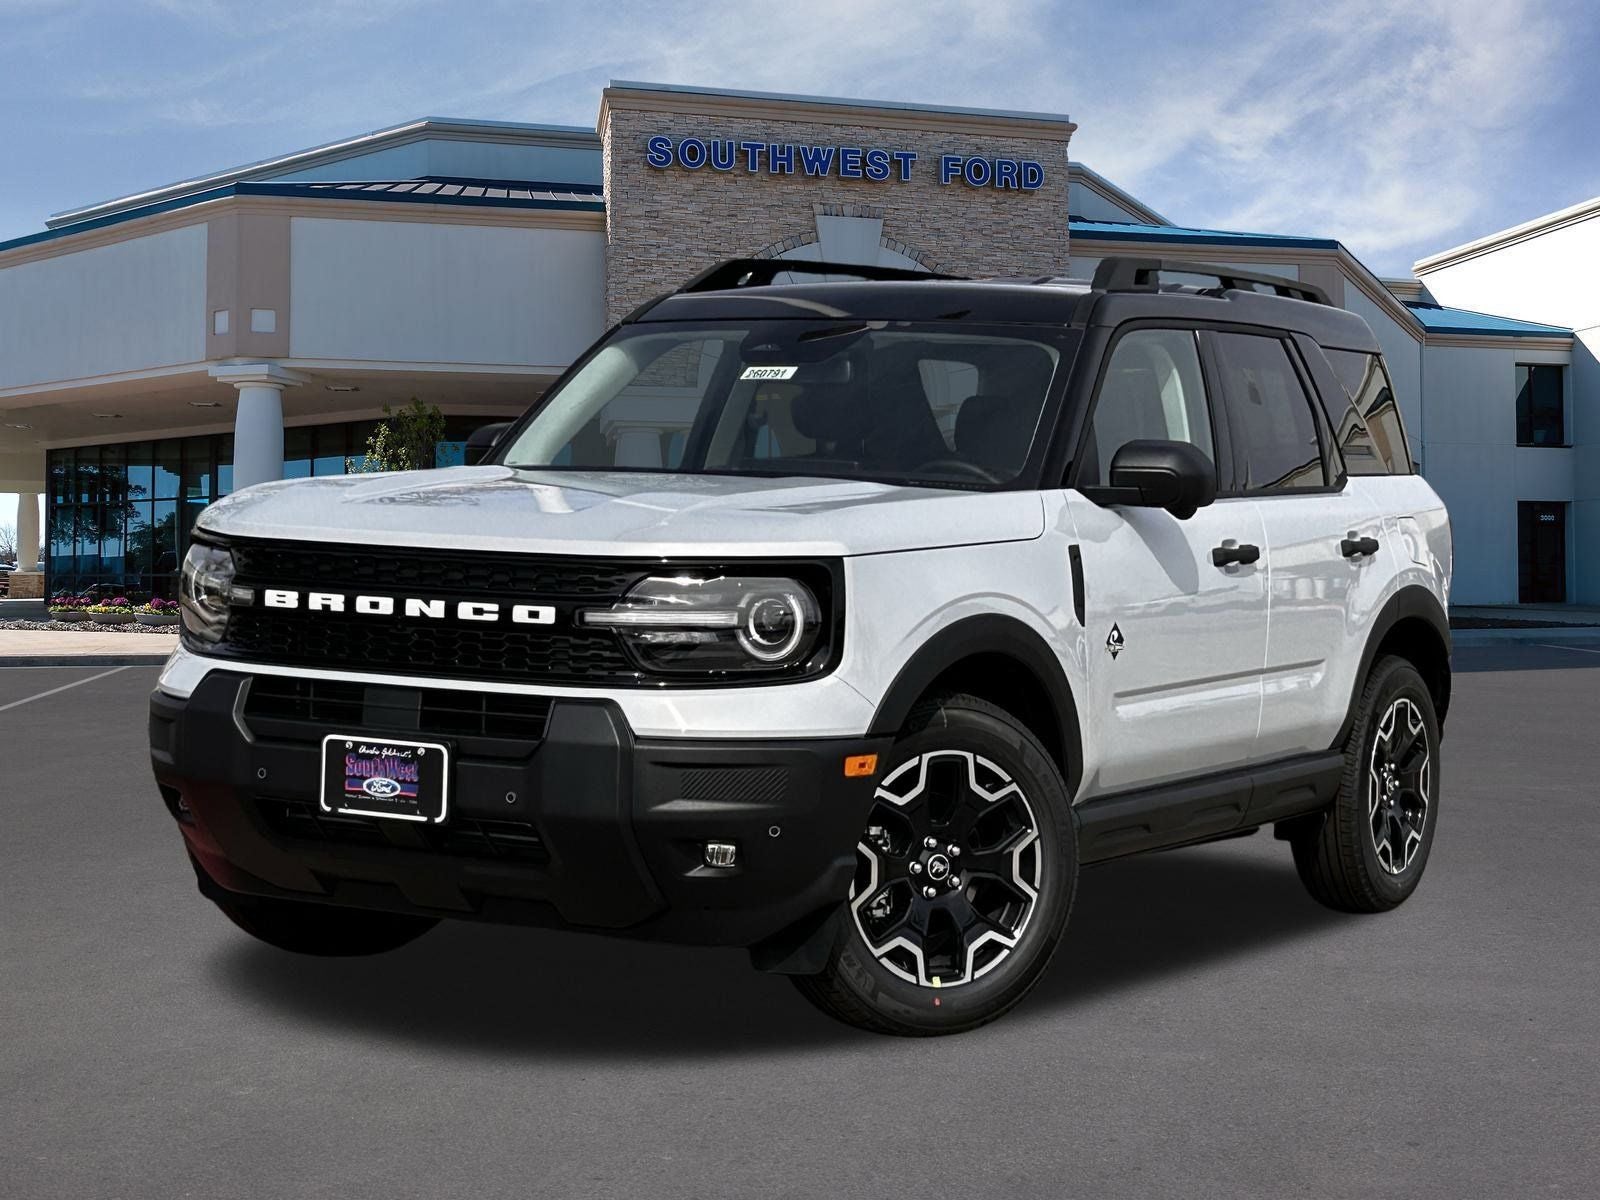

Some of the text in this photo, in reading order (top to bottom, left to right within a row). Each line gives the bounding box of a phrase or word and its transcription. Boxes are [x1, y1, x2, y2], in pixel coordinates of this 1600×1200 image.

[646, 135, 1046, 191] SOUTHWEST FORD
[264, 588, 556, 624] BRONCO
[370, 780, 393, 793] Ford
